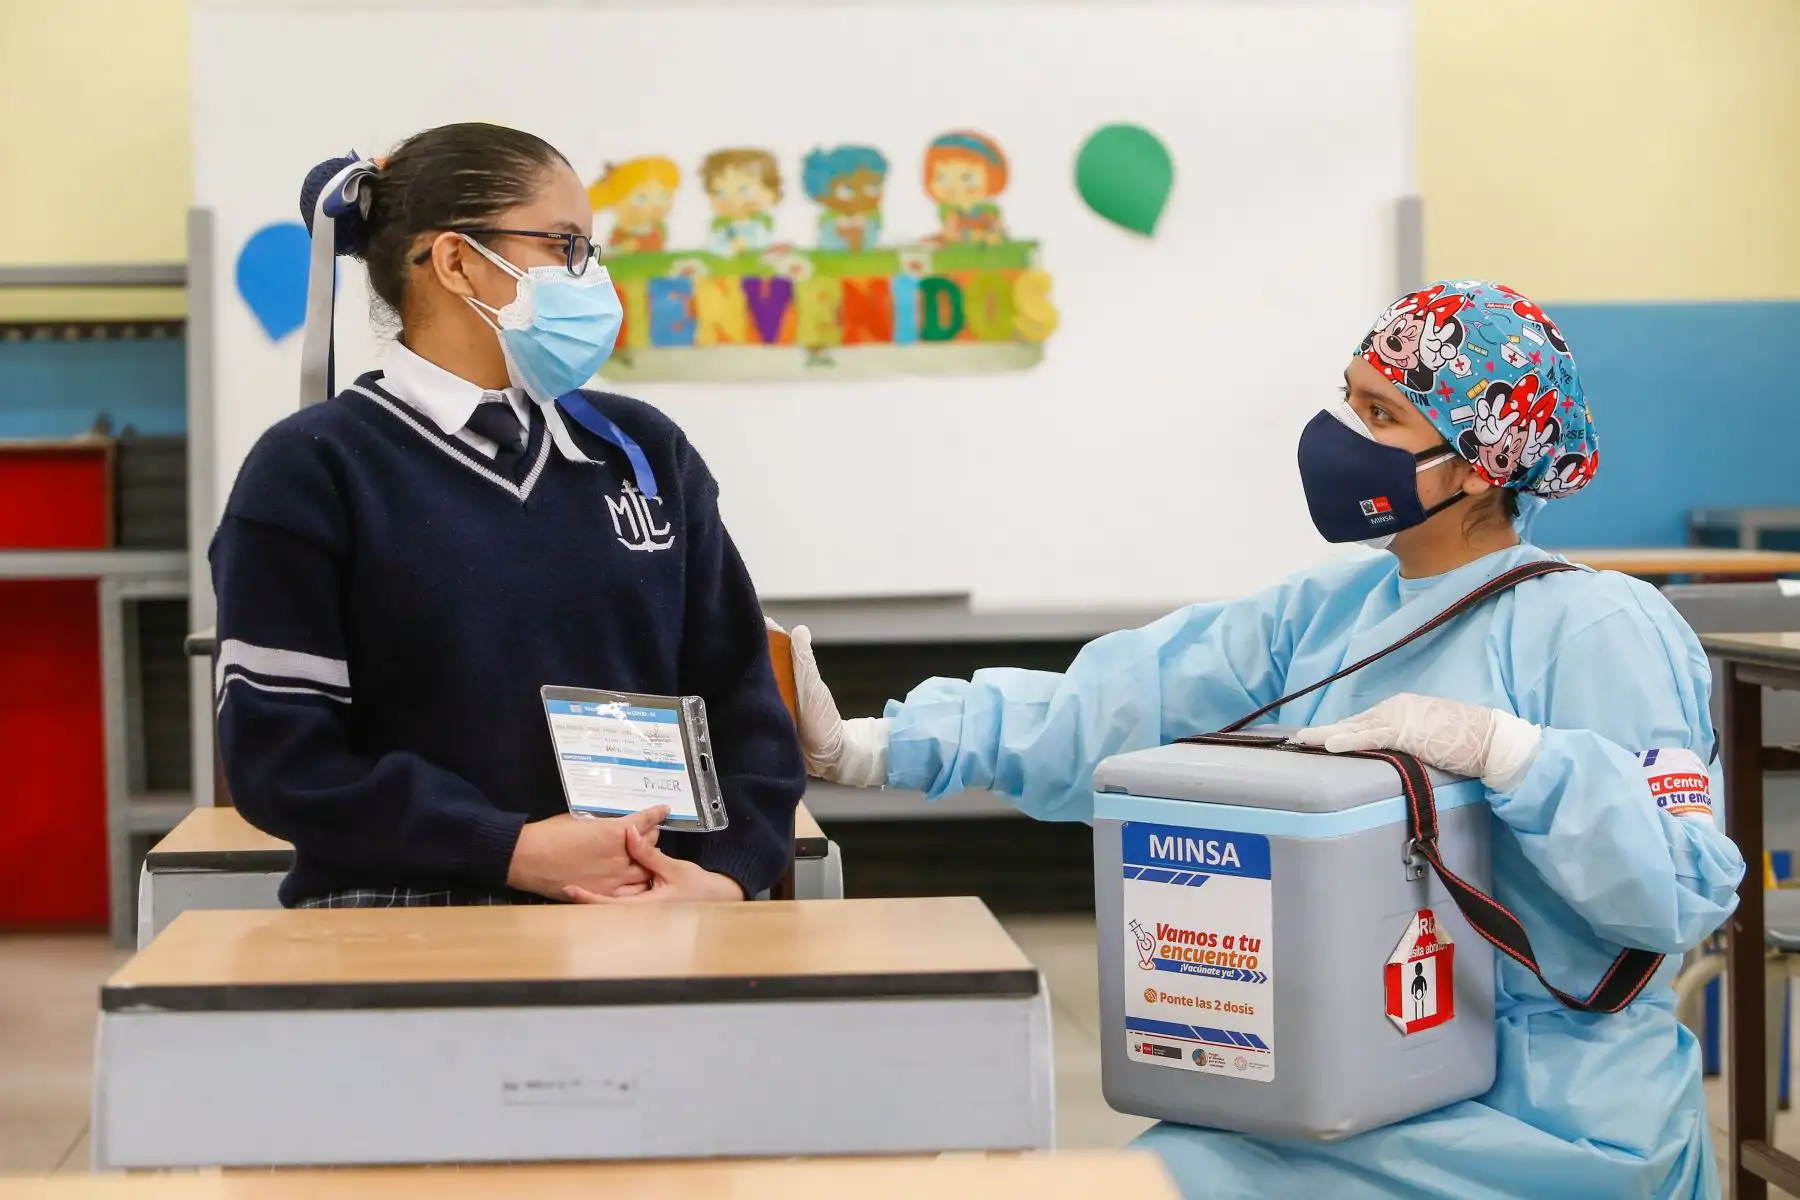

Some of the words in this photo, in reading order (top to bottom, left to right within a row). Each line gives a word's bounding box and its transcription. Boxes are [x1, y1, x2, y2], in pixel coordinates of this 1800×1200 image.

[614, 272, 1060, 348] IENVENIDOS
[1370, 514, 1394, 525] MINSA
[1657, 796, 1667, 807] a
[1670, 793, 1685, 803] tu
[1149, 834, 1241, 868] MINSA
[1156, 922, 1218, 948] Vamos
[1222, 935, 1235, 950] a
[1239, 934, 1261, 953] tu
[1160, 944, 1258, 970] encuentro
[1180, 963, 1221, 976] ¡Vacúnate
[1221, 969, 1234, 978] ya!
[1160, 992, 1194, 1007] Ponte
[1195, 997, 1212, 1010] las
[1214, 999, 1222, 1011] 2
[1223, 1001, 1254, 1015] dosis
